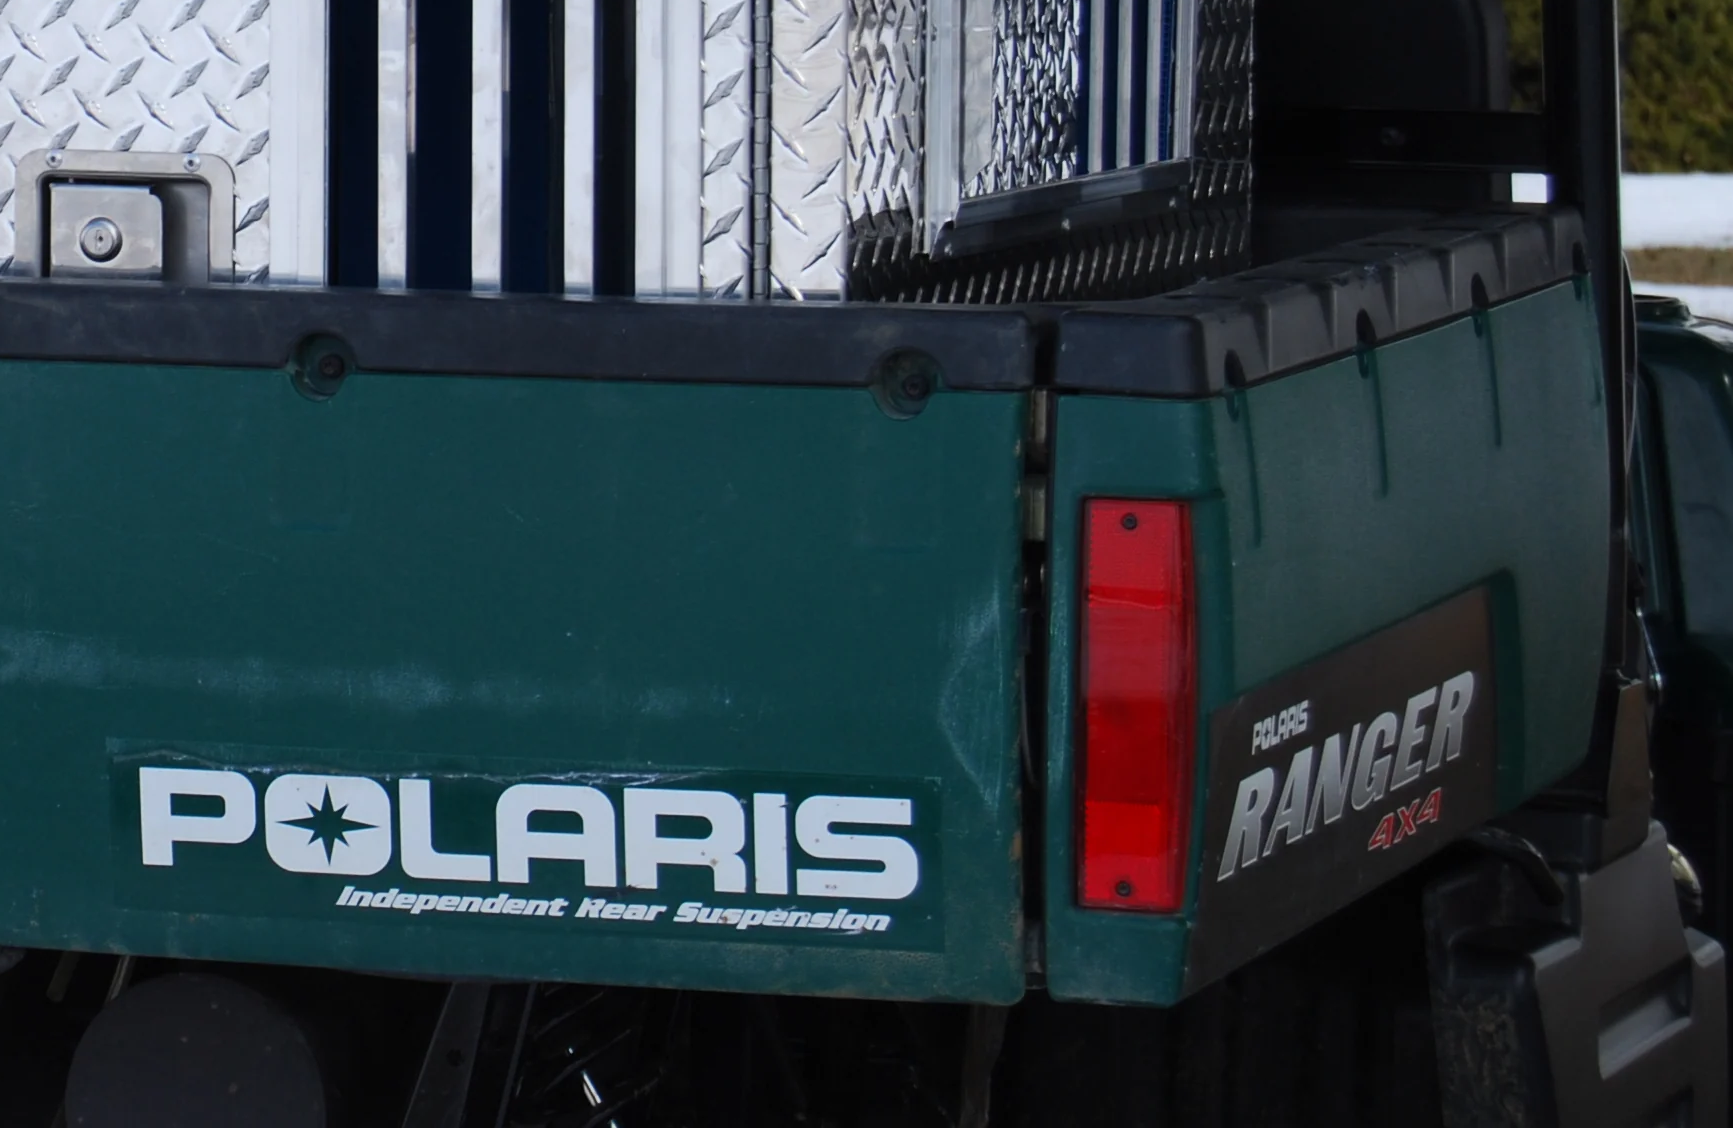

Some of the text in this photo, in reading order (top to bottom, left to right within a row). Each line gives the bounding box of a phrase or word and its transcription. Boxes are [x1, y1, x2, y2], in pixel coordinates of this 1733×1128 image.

[1251, 700, 1309, 755] POLARIS
[1217, 671, 1474, 882] RANGER
[139, 766, 920, 900] POLARIS
[335, 886, 891, 933] Independent Rear Suspension
